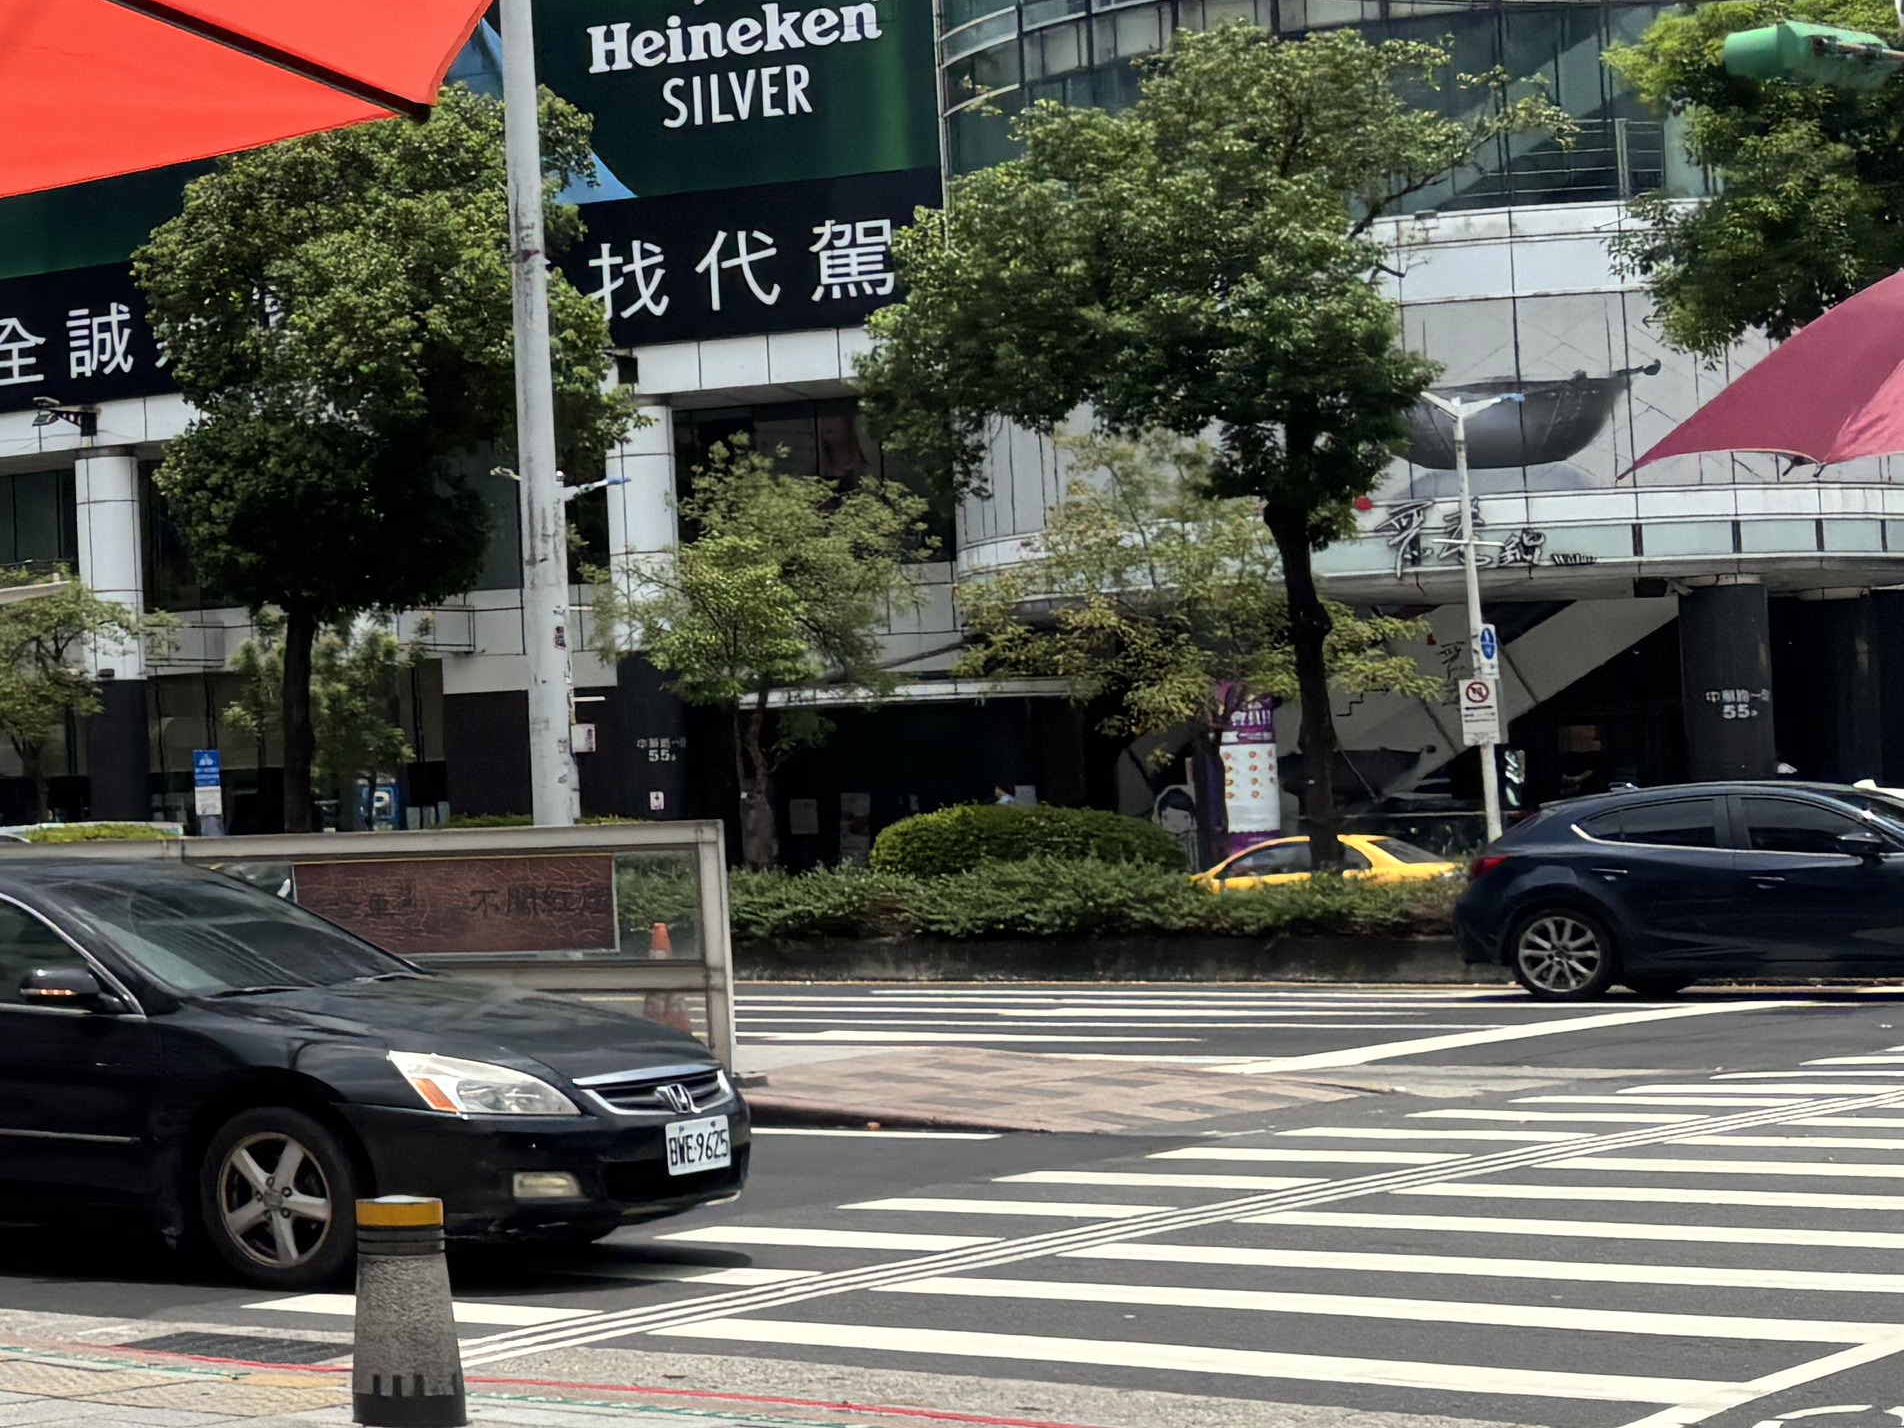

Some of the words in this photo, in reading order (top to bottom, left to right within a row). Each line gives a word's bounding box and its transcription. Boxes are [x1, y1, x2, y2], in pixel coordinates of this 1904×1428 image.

[586, 2, 883, 74] Heineken
[662, 63, 813, 130] SILVER
[588, 218, 896, 321] 找代駕
